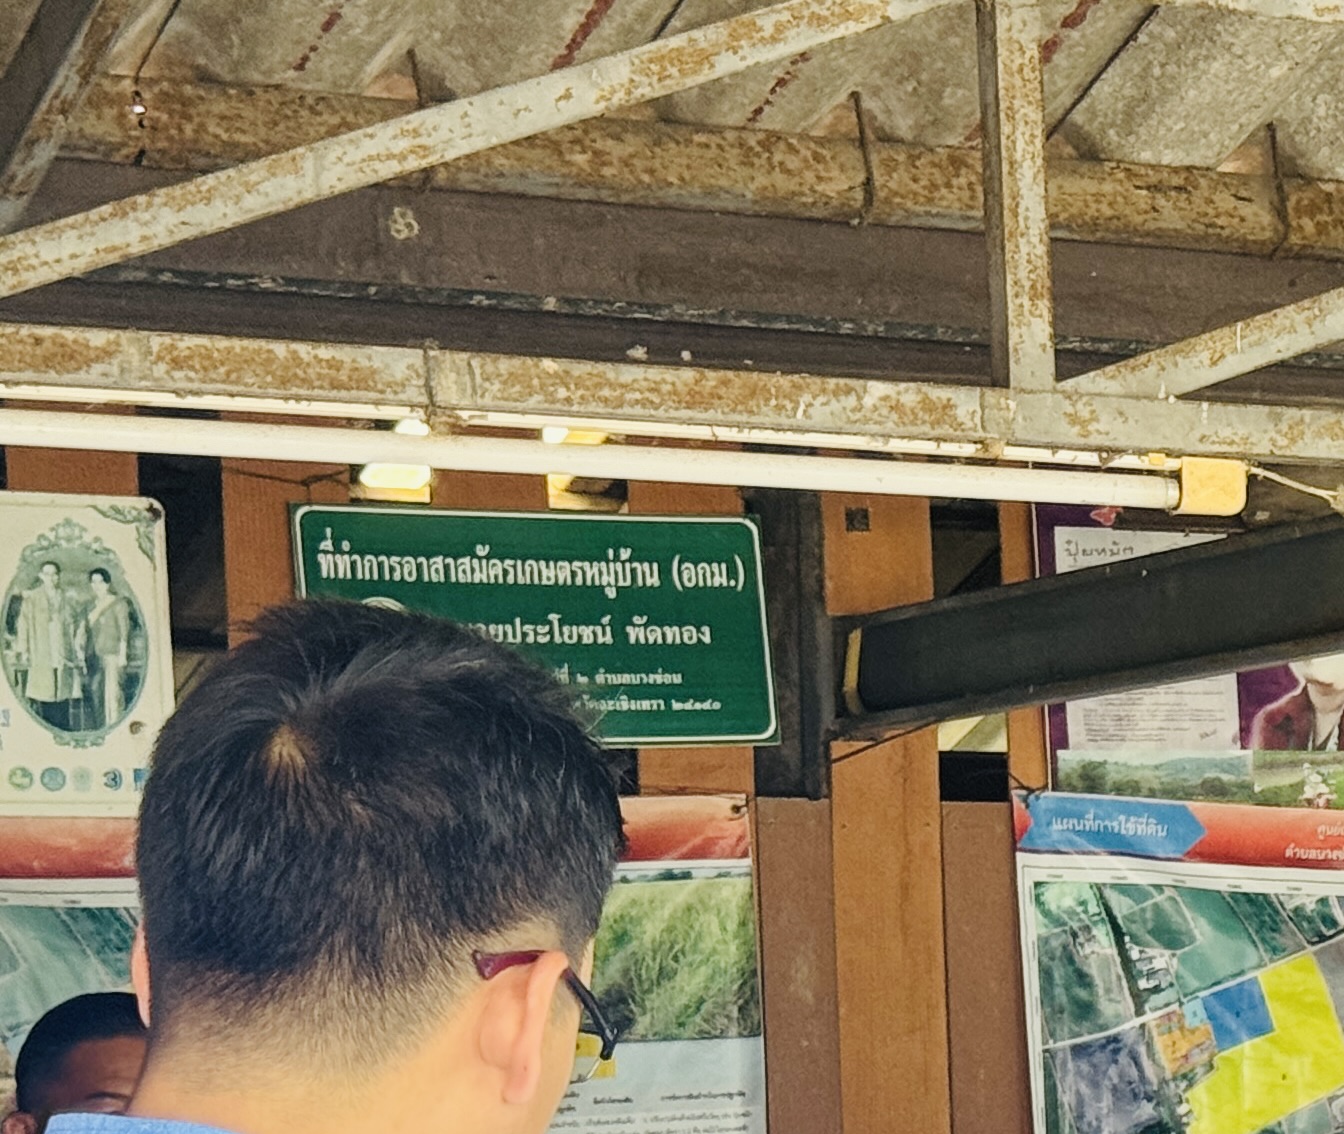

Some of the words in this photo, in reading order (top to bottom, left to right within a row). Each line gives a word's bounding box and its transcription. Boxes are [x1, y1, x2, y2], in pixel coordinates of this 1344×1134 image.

[317, 527, 661, 599] ที่ทำการอาสาสมัครเกษตรหมู่บ้าน
[672, 554, 745, 592] (อกม.)
[625, 615, 712, 645] พัดทอง
[1052, 809, 1168, 838] แผนที่การใช้ที่ดิน
